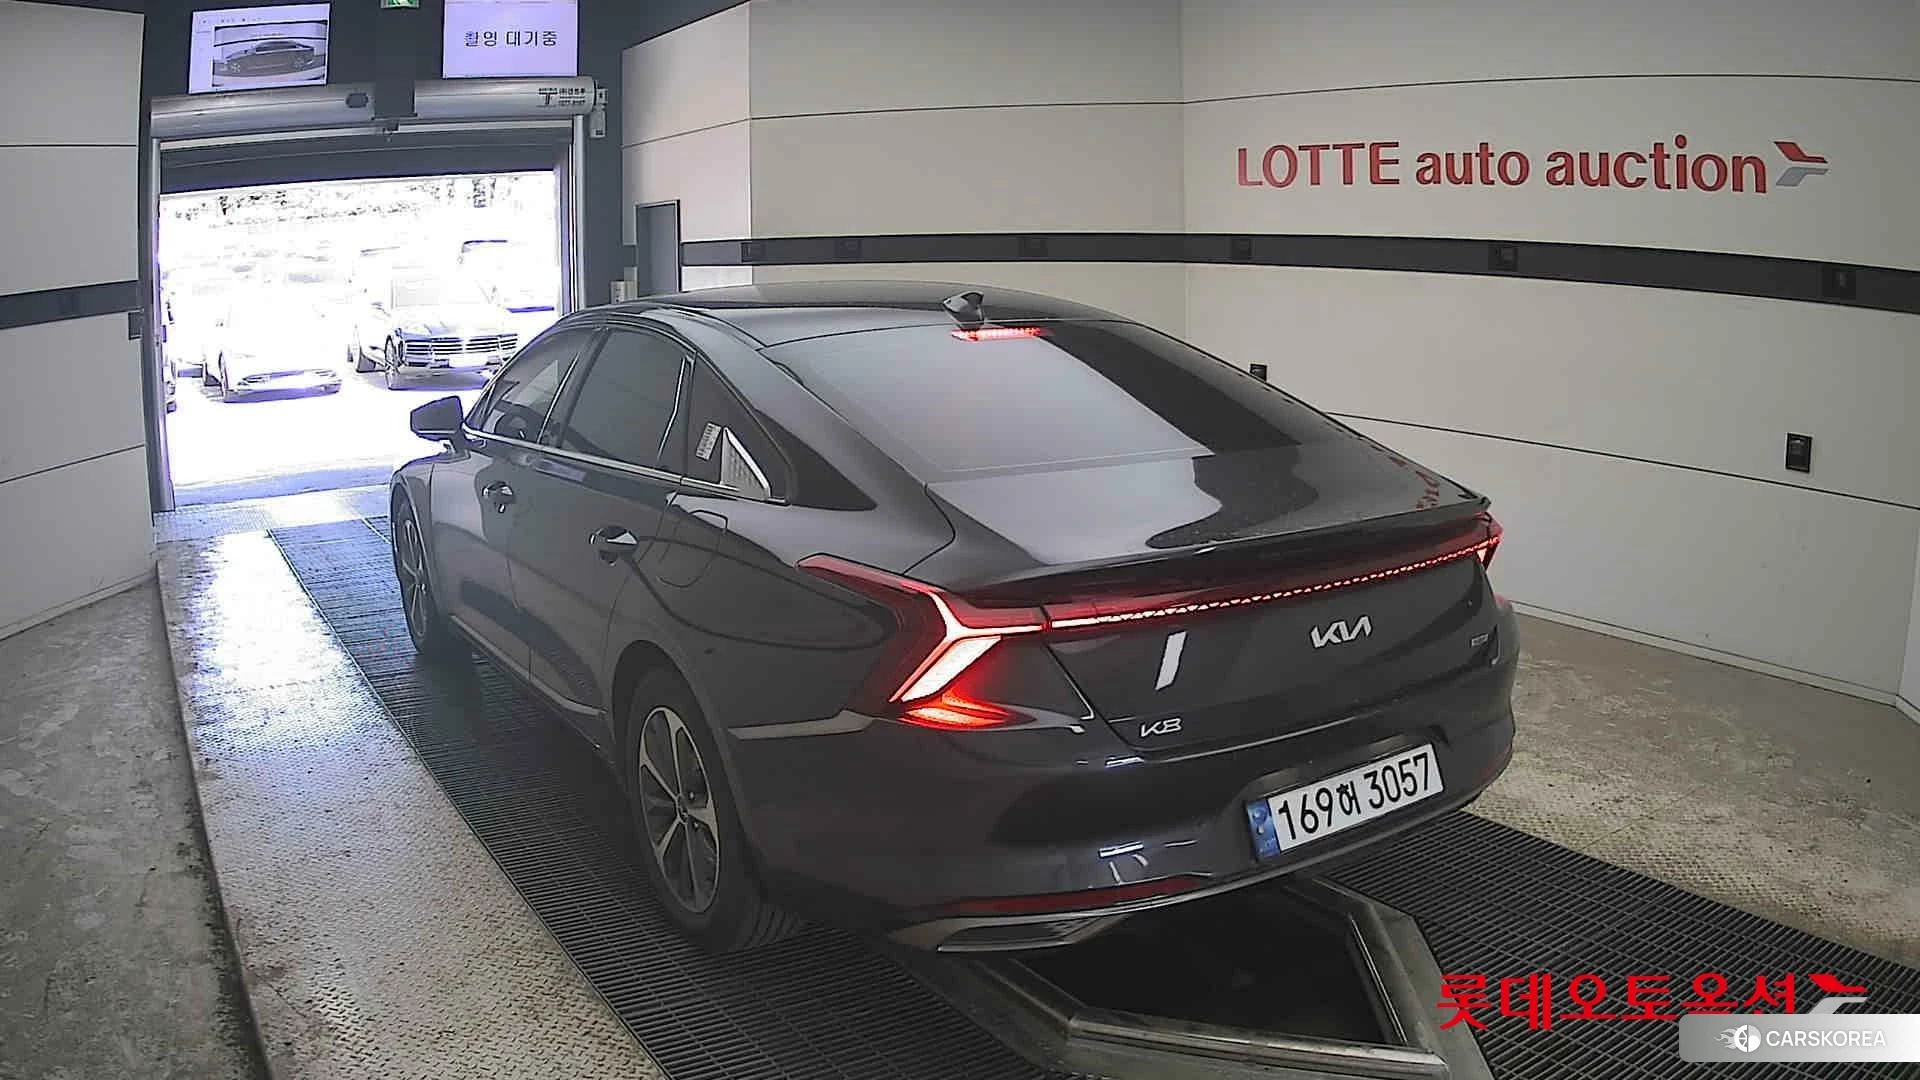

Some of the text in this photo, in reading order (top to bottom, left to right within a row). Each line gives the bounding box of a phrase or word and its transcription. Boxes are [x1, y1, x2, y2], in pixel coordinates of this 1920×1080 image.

[506, 31, 557, 47] 대기중
[1238, 134, 1767, 194] LOTTE auto auction
[1310, 616, 1371, 648] KIA
[1140, 718, 1182, 737] K8
[1278, 752, 1428, 840] 169허 3057
